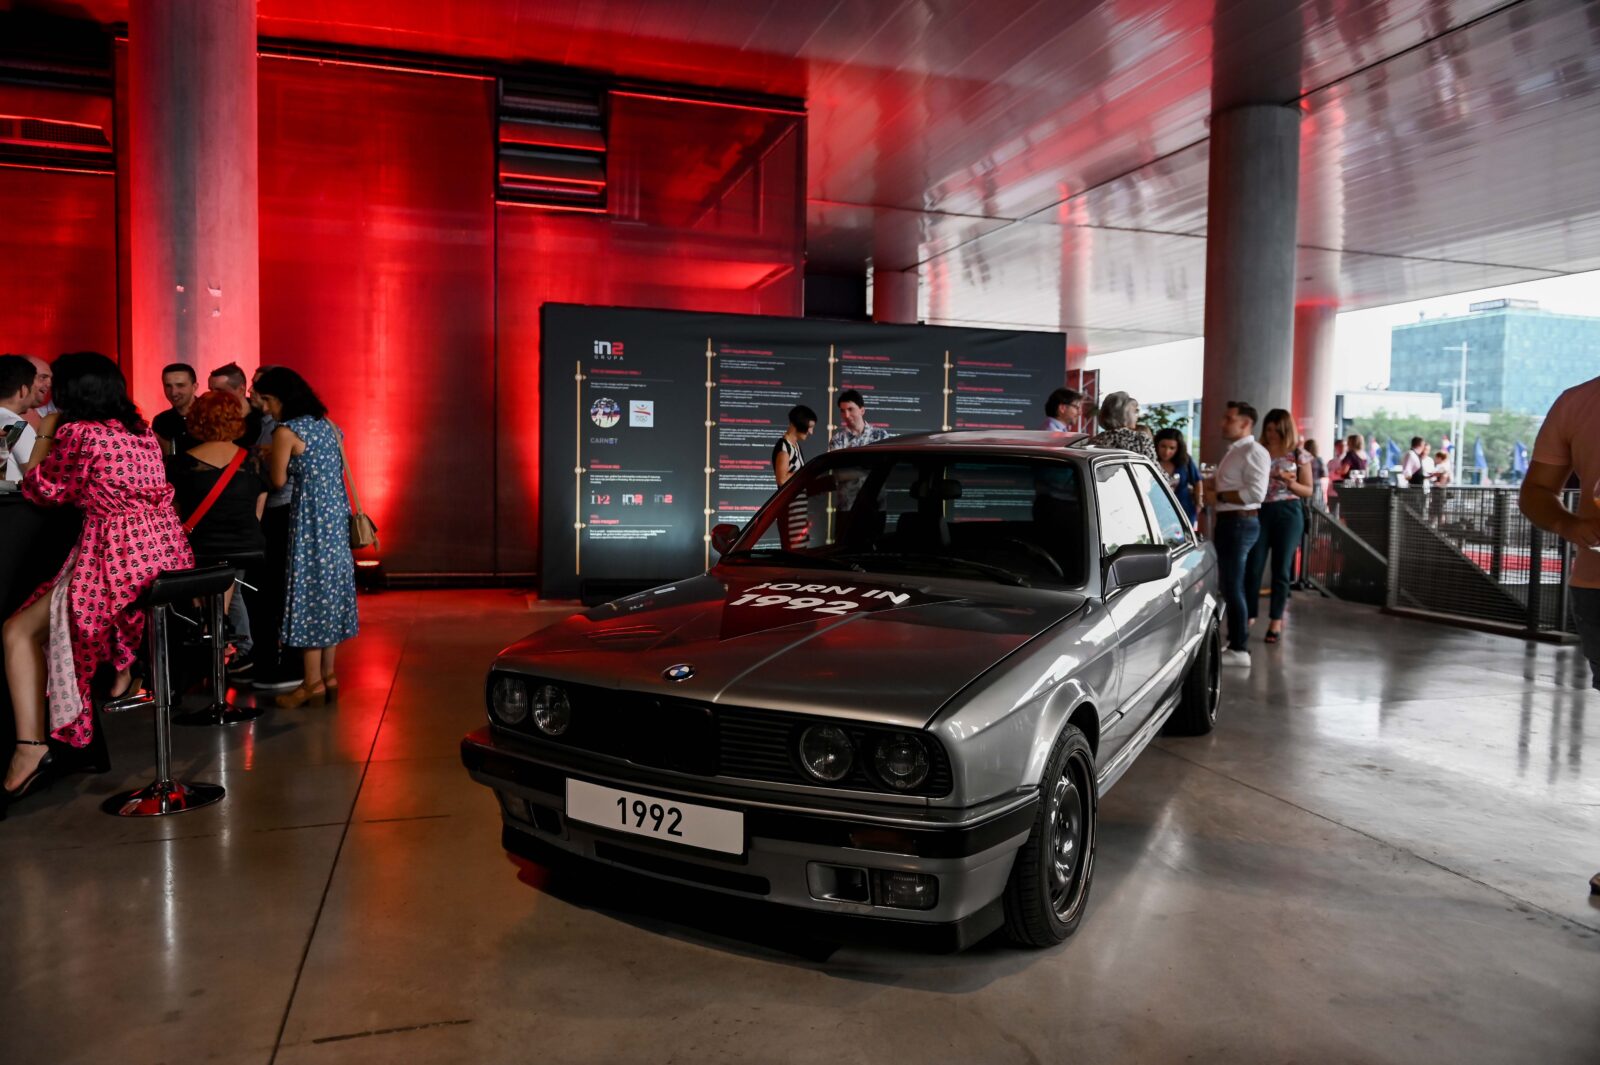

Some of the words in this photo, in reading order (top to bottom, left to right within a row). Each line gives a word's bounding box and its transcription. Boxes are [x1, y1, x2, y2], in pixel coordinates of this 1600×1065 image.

[594, 340, 624, 355] in2
[729, 594, 860, 615] 1992
[860, 589, 911, 605] IN
[616, 797, 683, 837] 1992
